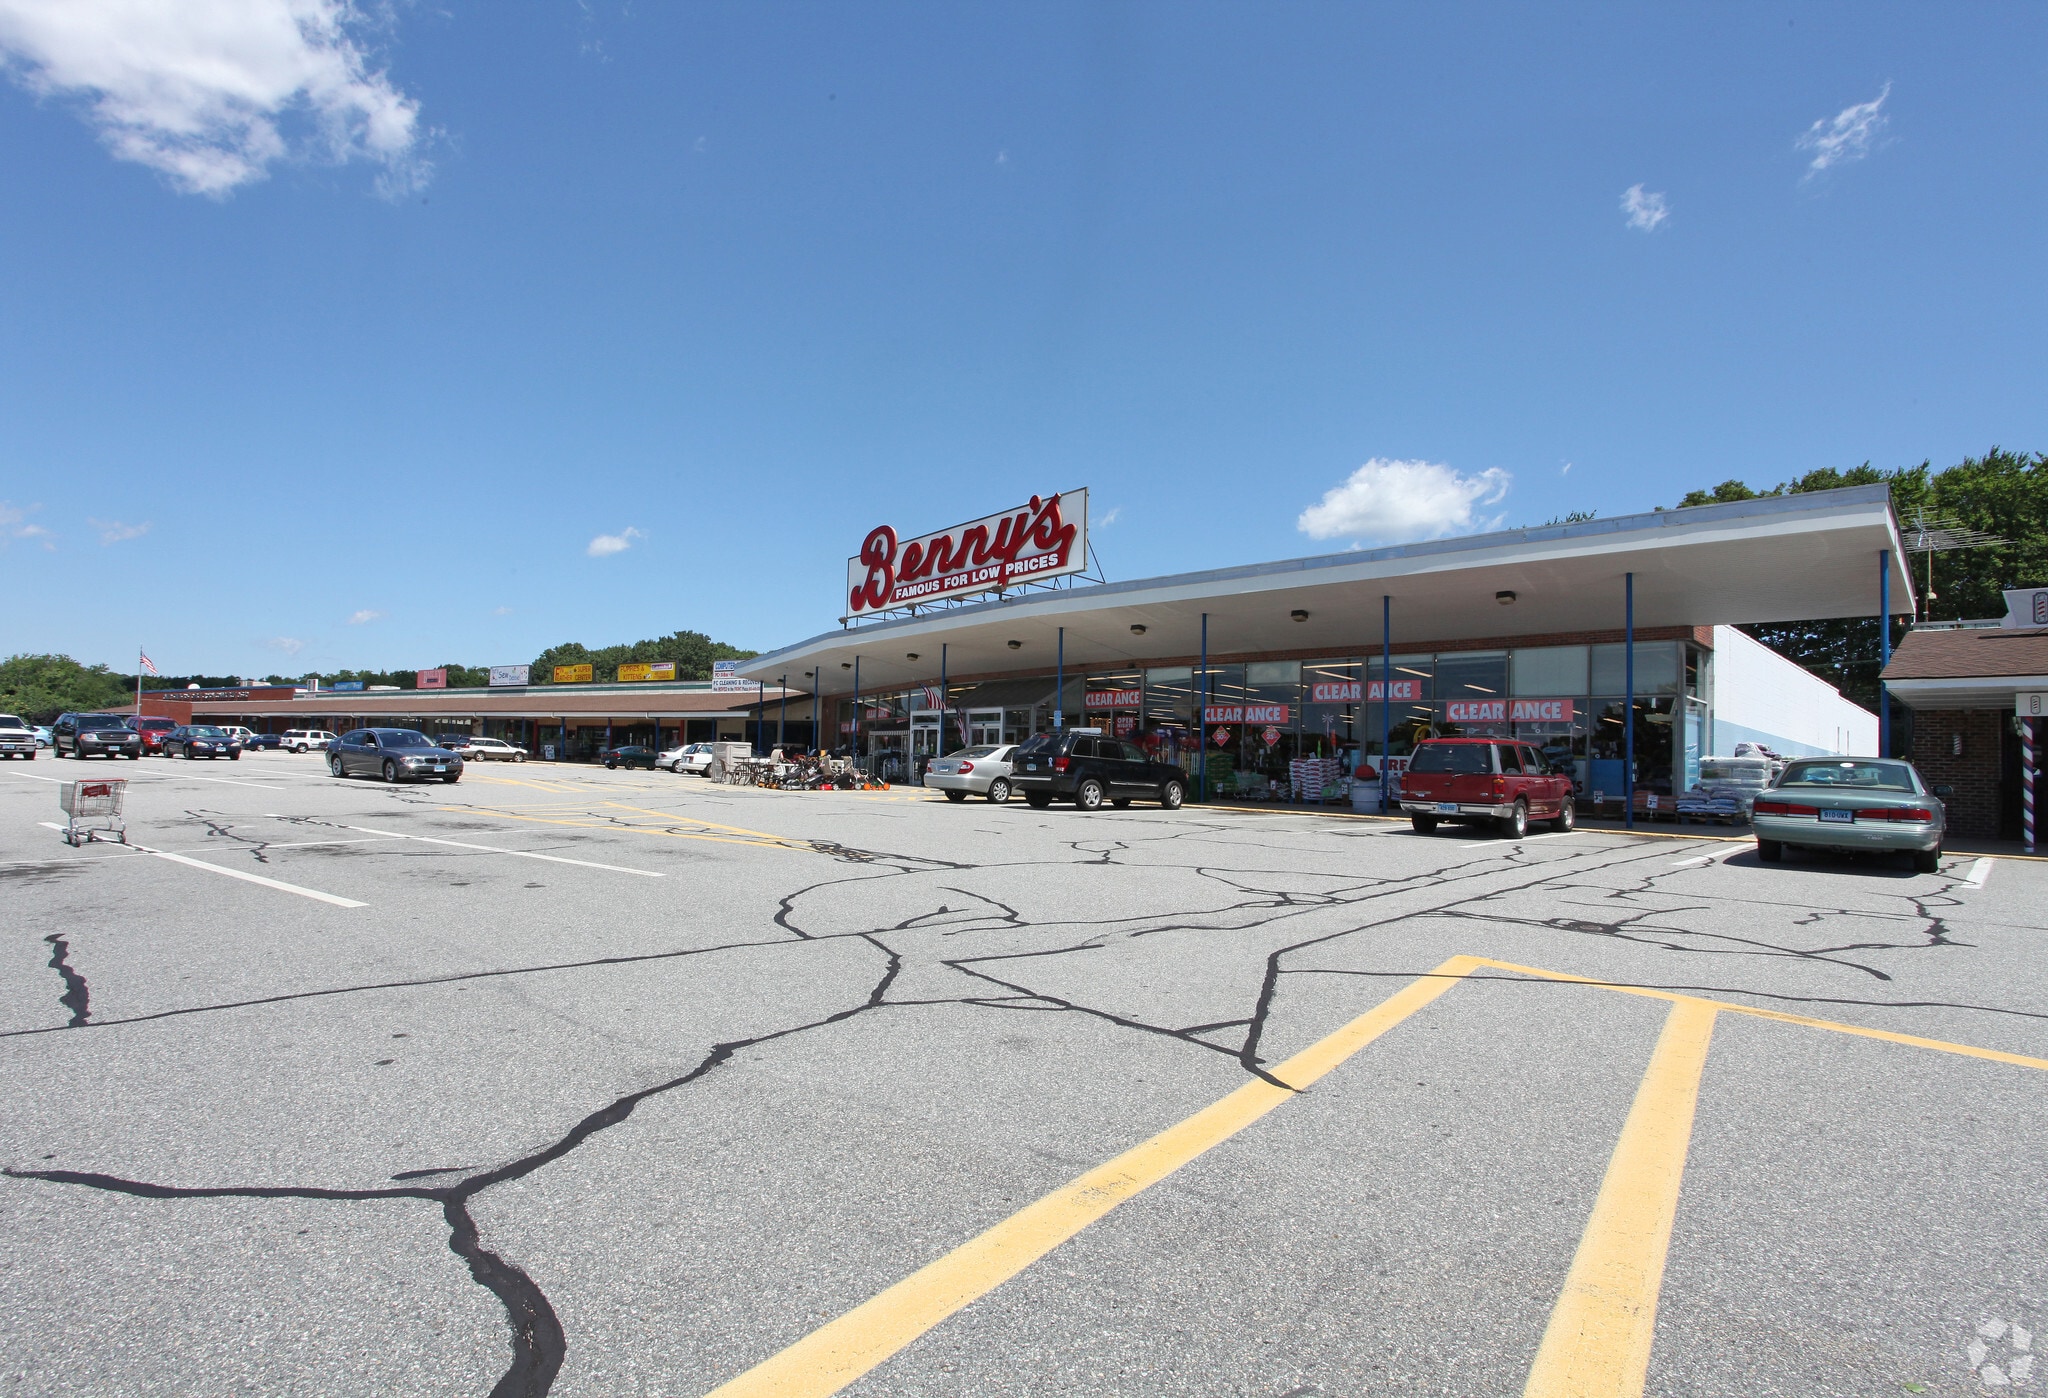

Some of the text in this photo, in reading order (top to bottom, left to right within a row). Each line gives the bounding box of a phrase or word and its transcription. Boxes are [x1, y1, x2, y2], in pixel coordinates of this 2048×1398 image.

[850, 492, 1077, 612] Benny's
[895, 553, 1059, 600] FAMOUS FOR LOW PRICES
